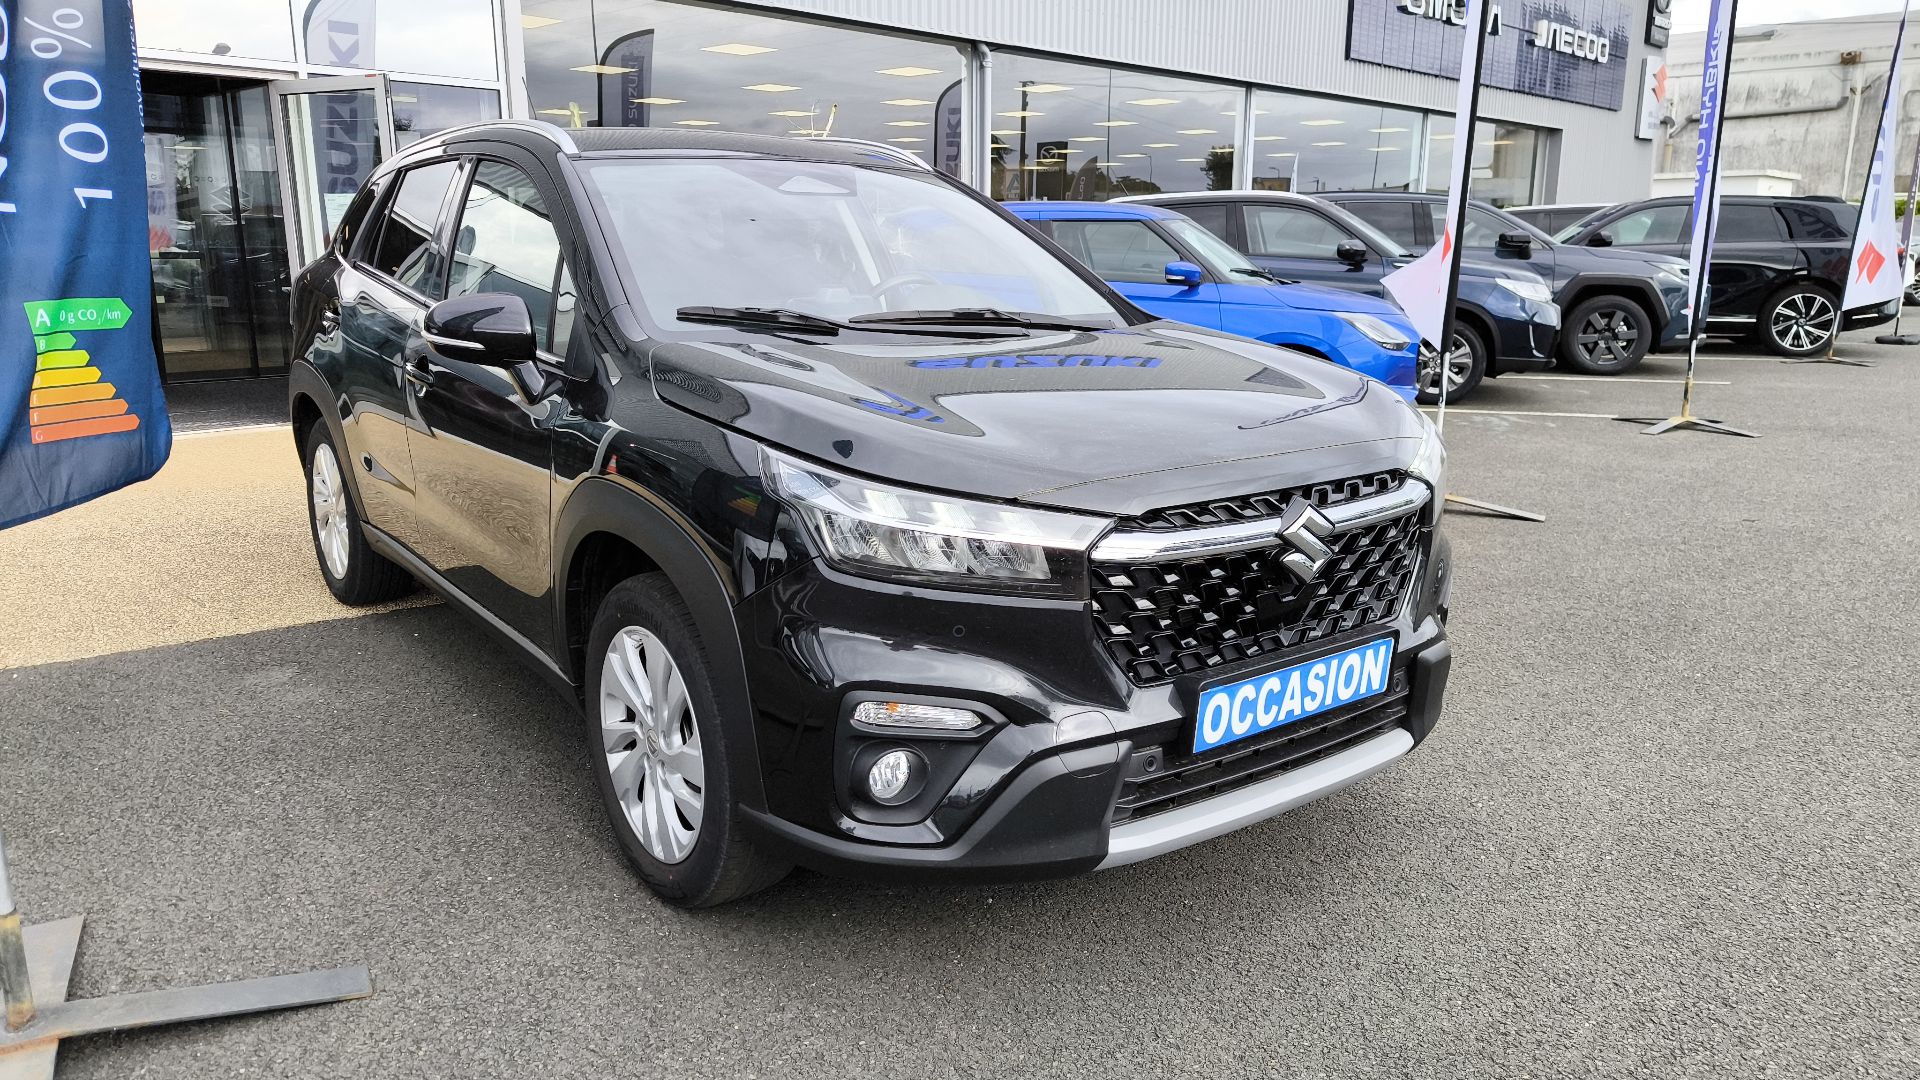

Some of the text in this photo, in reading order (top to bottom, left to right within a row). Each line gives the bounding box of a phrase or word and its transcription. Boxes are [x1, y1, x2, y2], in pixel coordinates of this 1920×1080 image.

[1404, 0, 1502, 36] MOA
[1534, 19, 1610, 64] JAECOO
[24, 8, 113, 209] 100%
[628, 61, 639, 119] SUZUI
[35, 308, 51, 327] A
[68, 311, 75, 324] g
[35, 430, 43, 441] G
[1202, 645, 1387, 744] OCCASION
